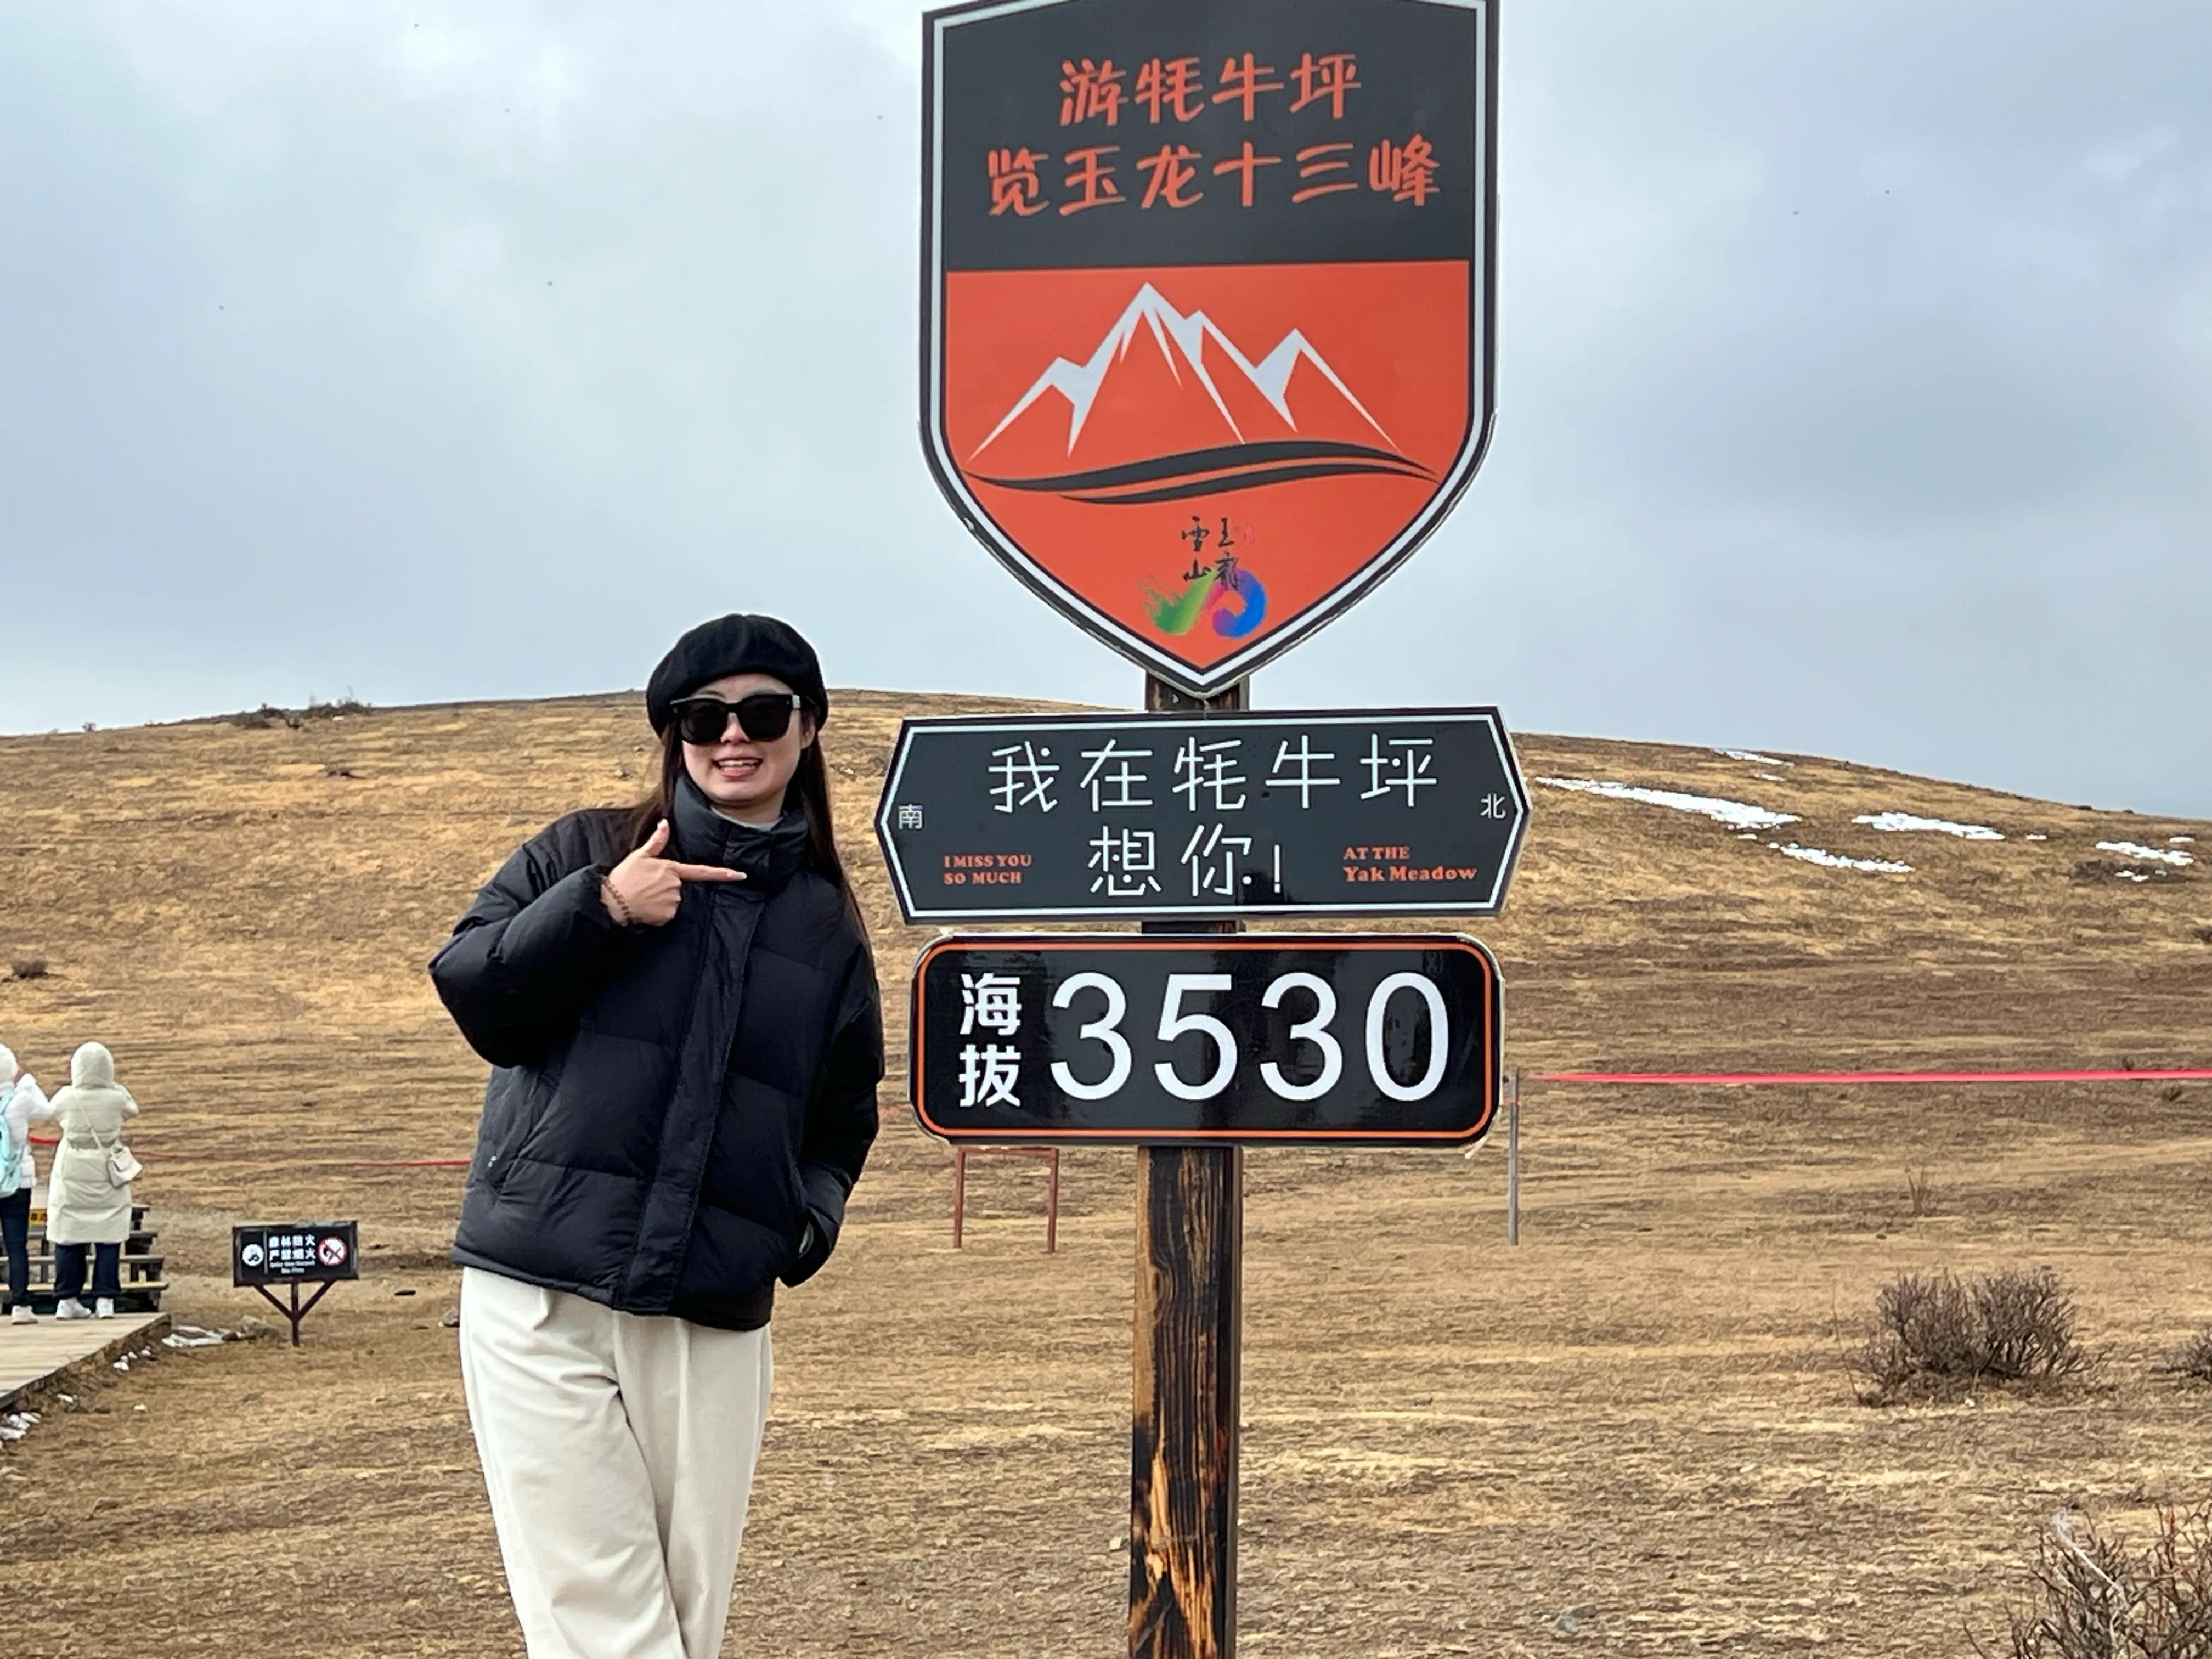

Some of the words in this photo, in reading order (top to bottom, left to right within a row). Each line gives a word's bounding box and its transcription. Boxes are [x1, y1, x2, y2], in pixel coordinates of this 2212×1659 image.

[1060, 52, 1362, 125] 游牦牛坪
[988, 134, 1440, 215] 览玉龙十三峰
[988, 733, 1437, 814] 我在牦牛坪
[899, 804, 923, 830] 南
[1480, 793, 1506, 819] 北
[944, 855, 951, 868] I
[953, 855, 994, 868] MISS
[996, 854, 1032, 867] YOU
[1343, 847, 1368, 860] AT
[1372, 845, 1410, 860] THE
[944, 872, 966, 885] SO
[972, 871, 1022, 884] MUCH
[1343, 866, 1385, 882] Yak
[1389, 865, 1477, 881] Meadow
[958, 973, 1022, 1108] 海拔
[1050, 972, 1449, 1102] 3530
